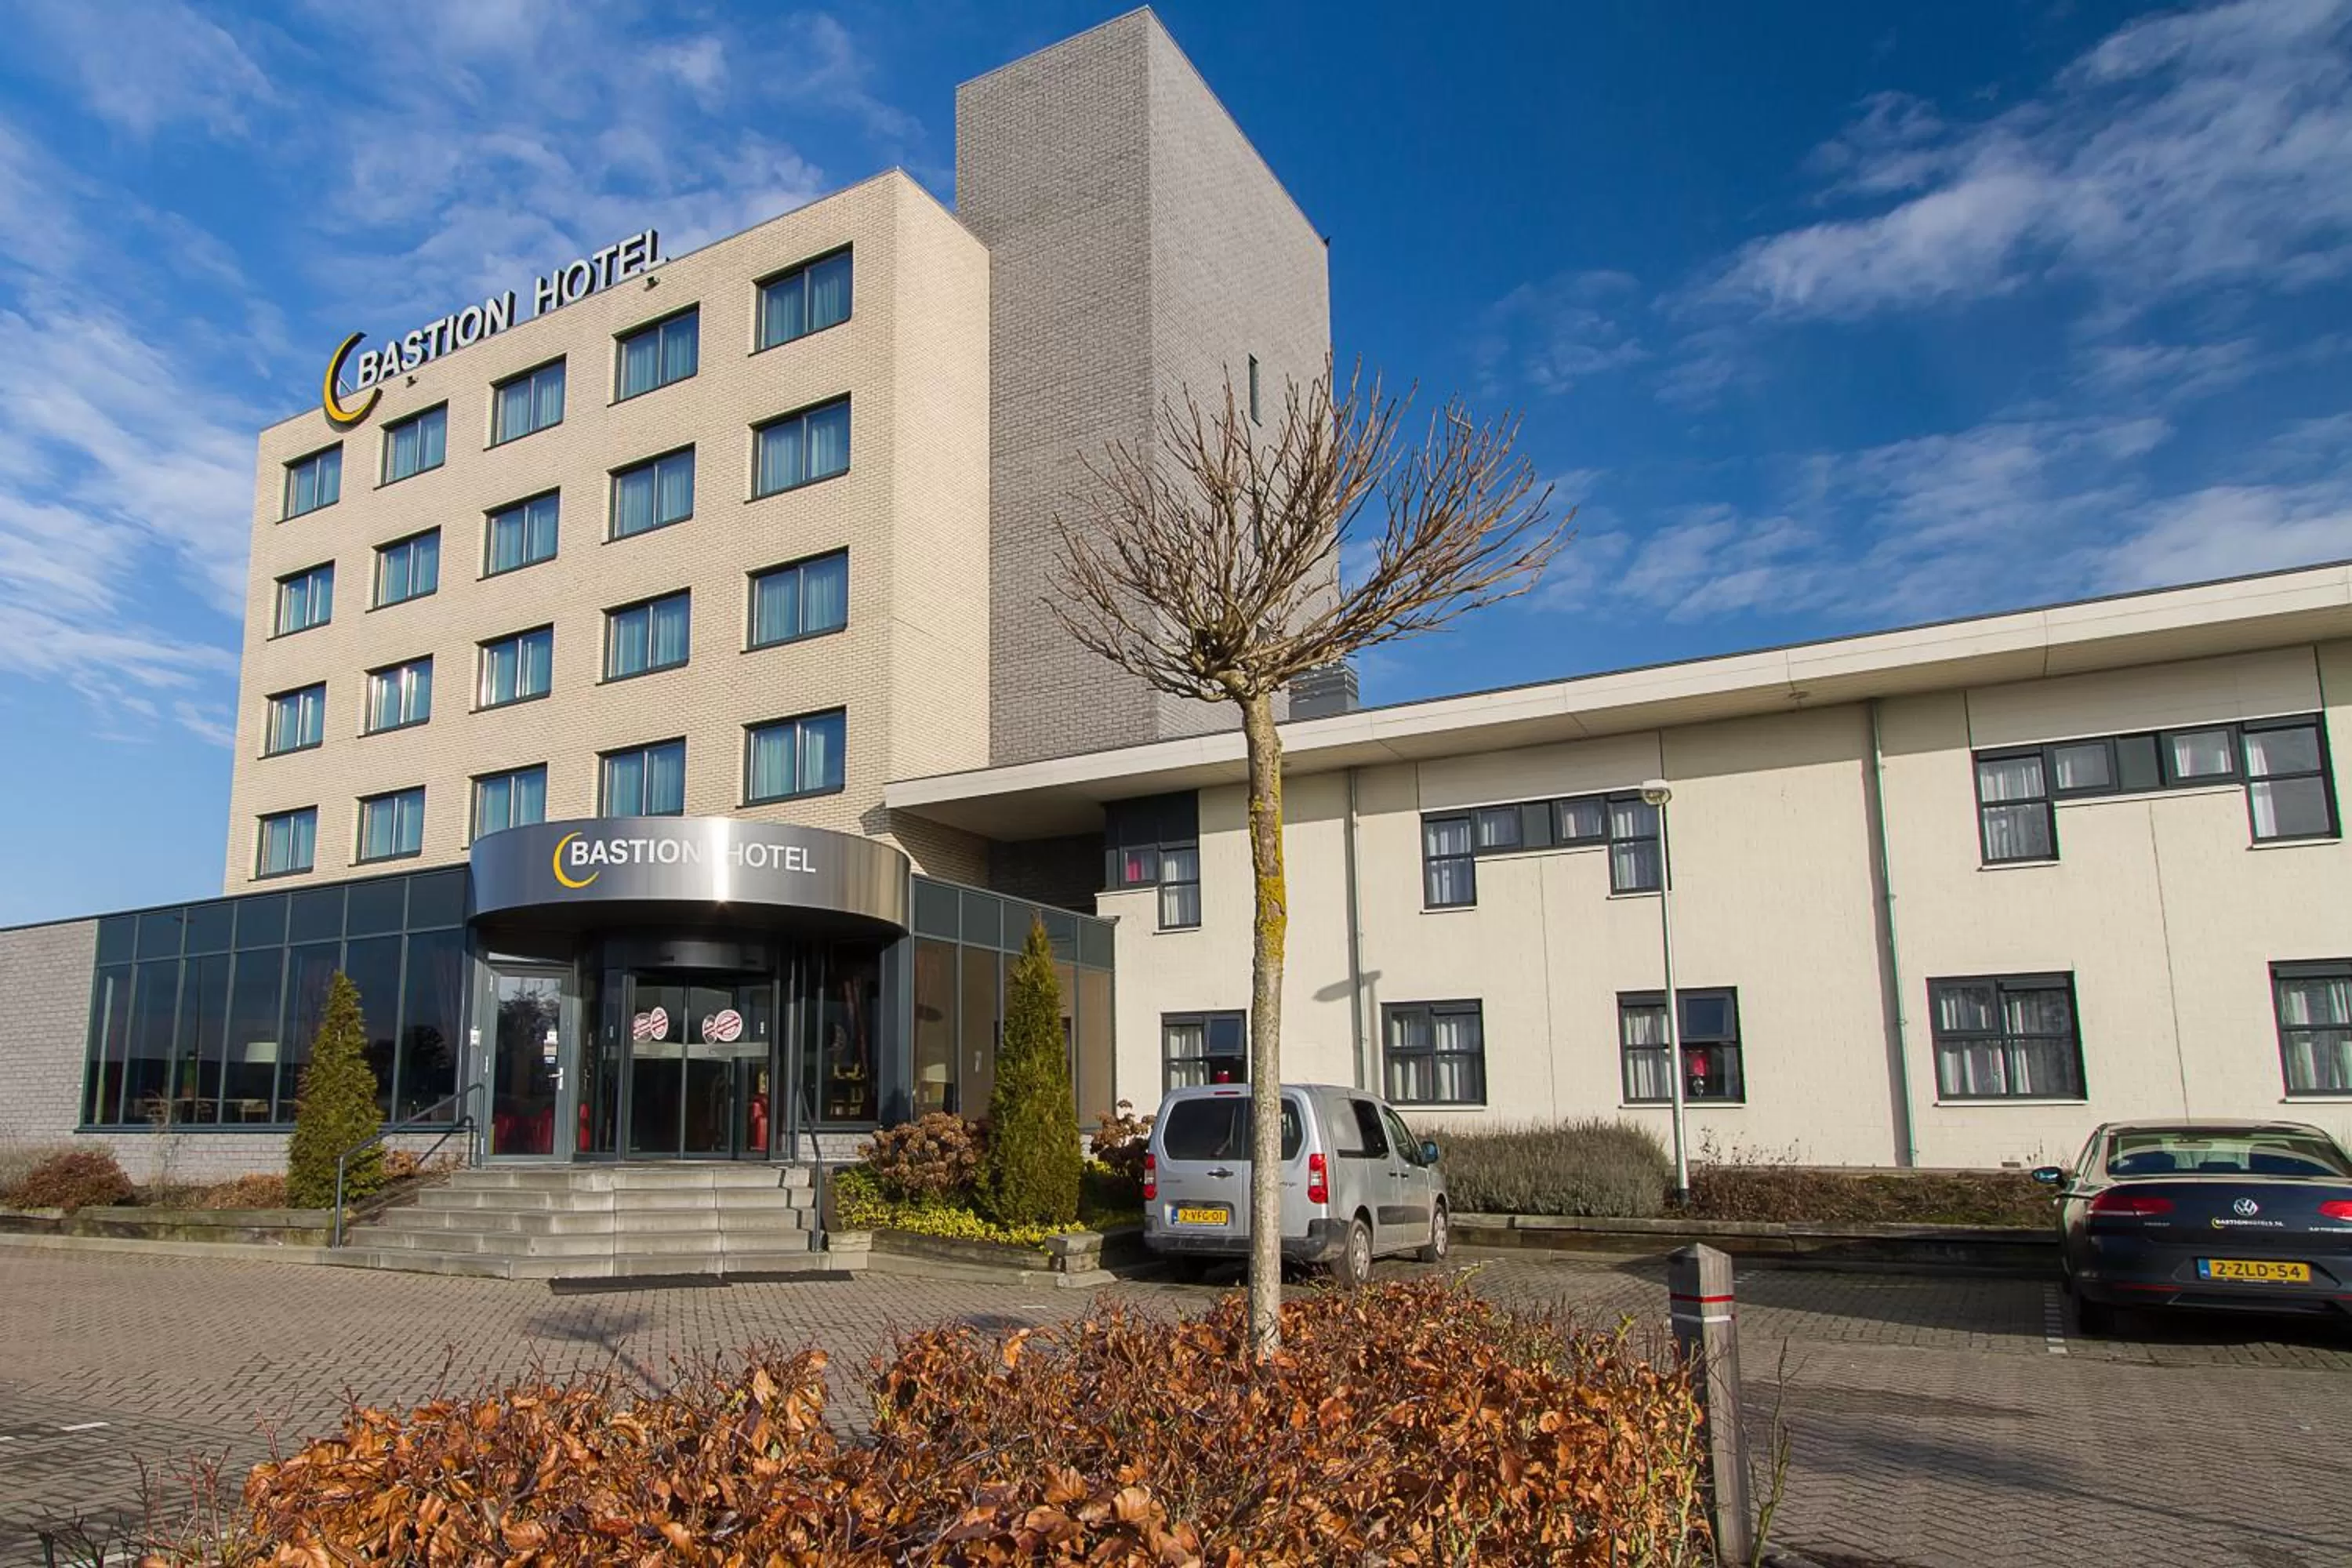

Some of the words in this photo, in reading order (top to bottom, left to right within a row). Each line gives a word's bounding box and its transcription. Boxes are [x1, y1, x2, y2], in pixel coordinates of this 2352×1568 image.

[357, 290, 516, 390] BASTION
[535, 229, 669, 315] HOTEL
[571, 839, 702, 866] BASTION
[726, 842, 816, 873] HOTEL
[2216, 1261, 2300, 1278] 2-ZLD-54
